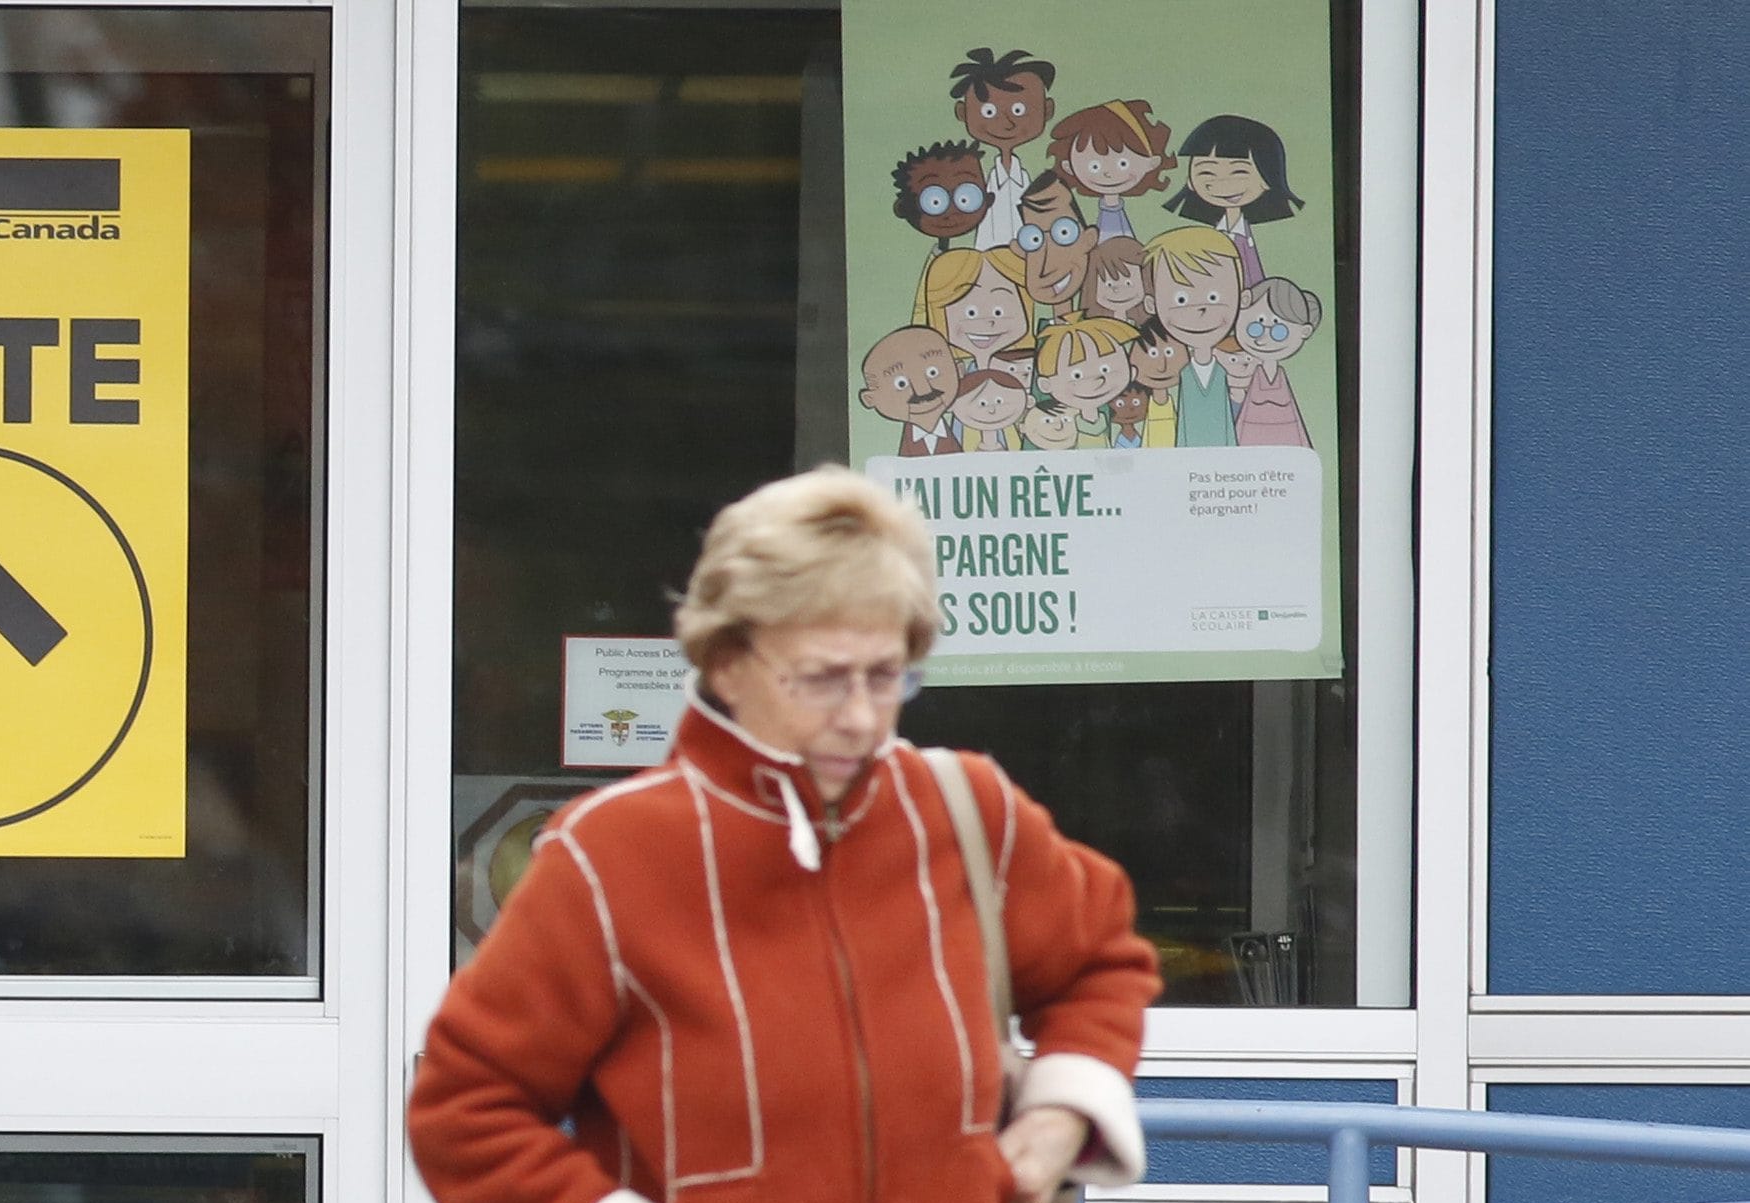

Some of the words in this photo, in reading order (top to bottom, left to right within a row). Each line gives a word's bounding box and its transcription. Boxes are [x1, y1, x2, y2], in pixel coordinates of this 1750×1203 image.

[1189, 472, 1211, 483] Pas
[1214, 471, 1256, 482] besoin
[1259, 470, 1295, 482] d'être
[952, 476, 999, 520] UN
[1010, 465, 1122, 518] RÊVE...
[1189, 487, 1225, 502] grand
[1229, 488, 1257, 501] pour
[1261, 486, 1287, 498] être
[1189, 503, 1258, 517] épargnant!
[936, 532, 1070, 578] PARGNE
[968, 590, 1059, 636] SOUS
[1210, 609, 1252, 620] CAISSE
[1192, 620, 1252, 631] SCOLAIRE
[595, 647, 624, 657] Public
[626, 648, 660, 658] Access
[598, 667, 653, 679] Programme
[656, 667, 668, 677] de
